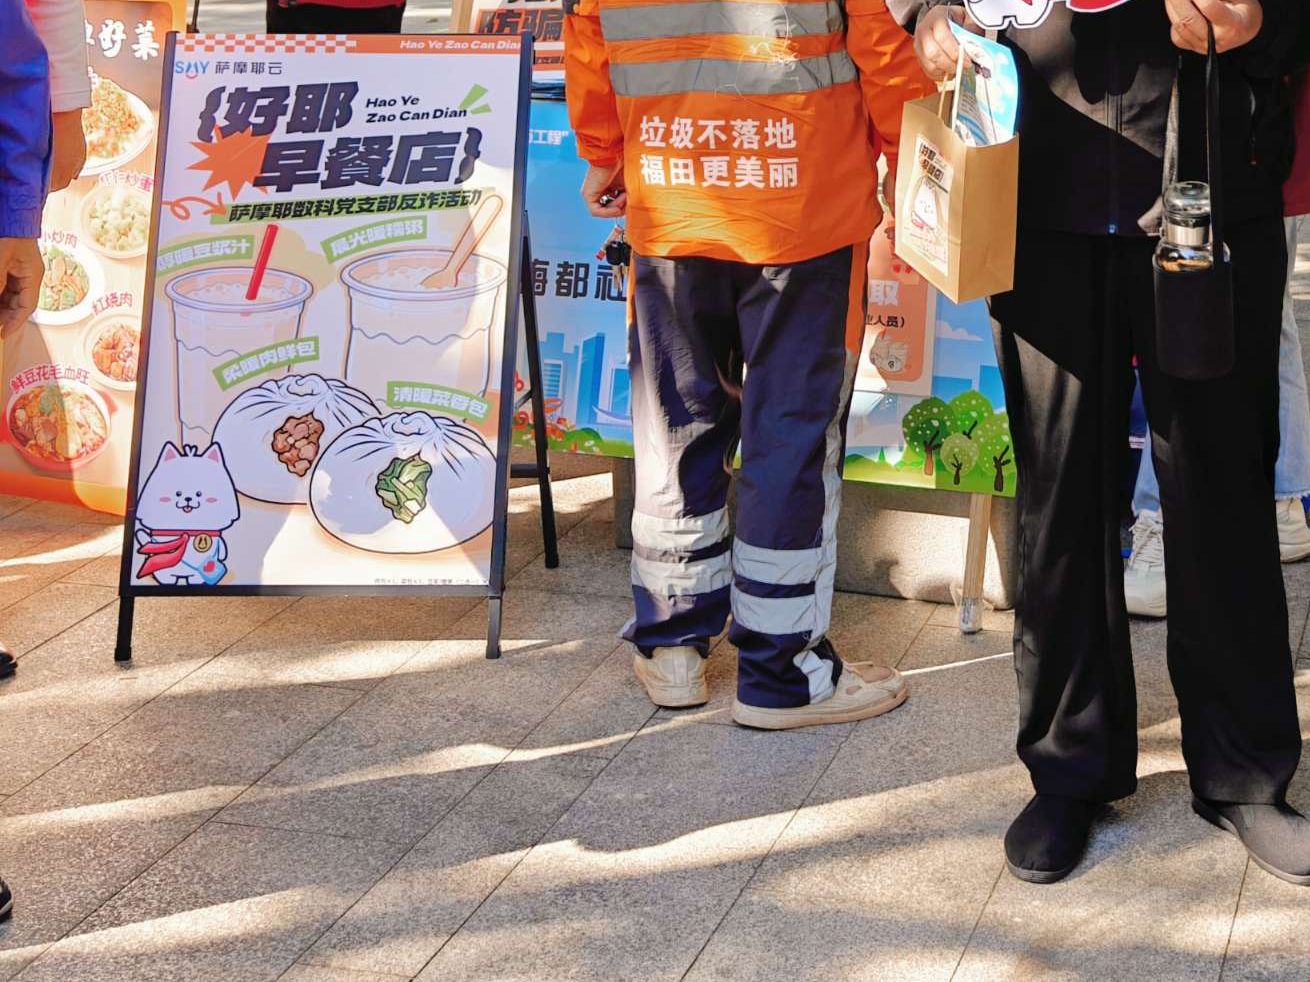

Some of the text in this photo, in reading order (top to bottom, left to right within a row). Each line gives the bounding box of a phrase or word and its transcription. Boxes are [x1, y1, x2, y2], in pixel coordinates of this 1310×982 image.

[400, 40, 425, 50] Hao
[444, 39, 469, 50] Zao
[470, 39, 497, 50] Can
[215, 61, 282, 75] 萨摩耶云
[365, 96, 420, 110] Hao Ye
[366, 107, 467, 124] Zao Can Dian
[640, 116, 797, 150] 垃圾不落地
[640, 153, 798, 188] 福田更美丽
[228, 189, 481, 222] 萨摩耶数科党支部反诈活动
